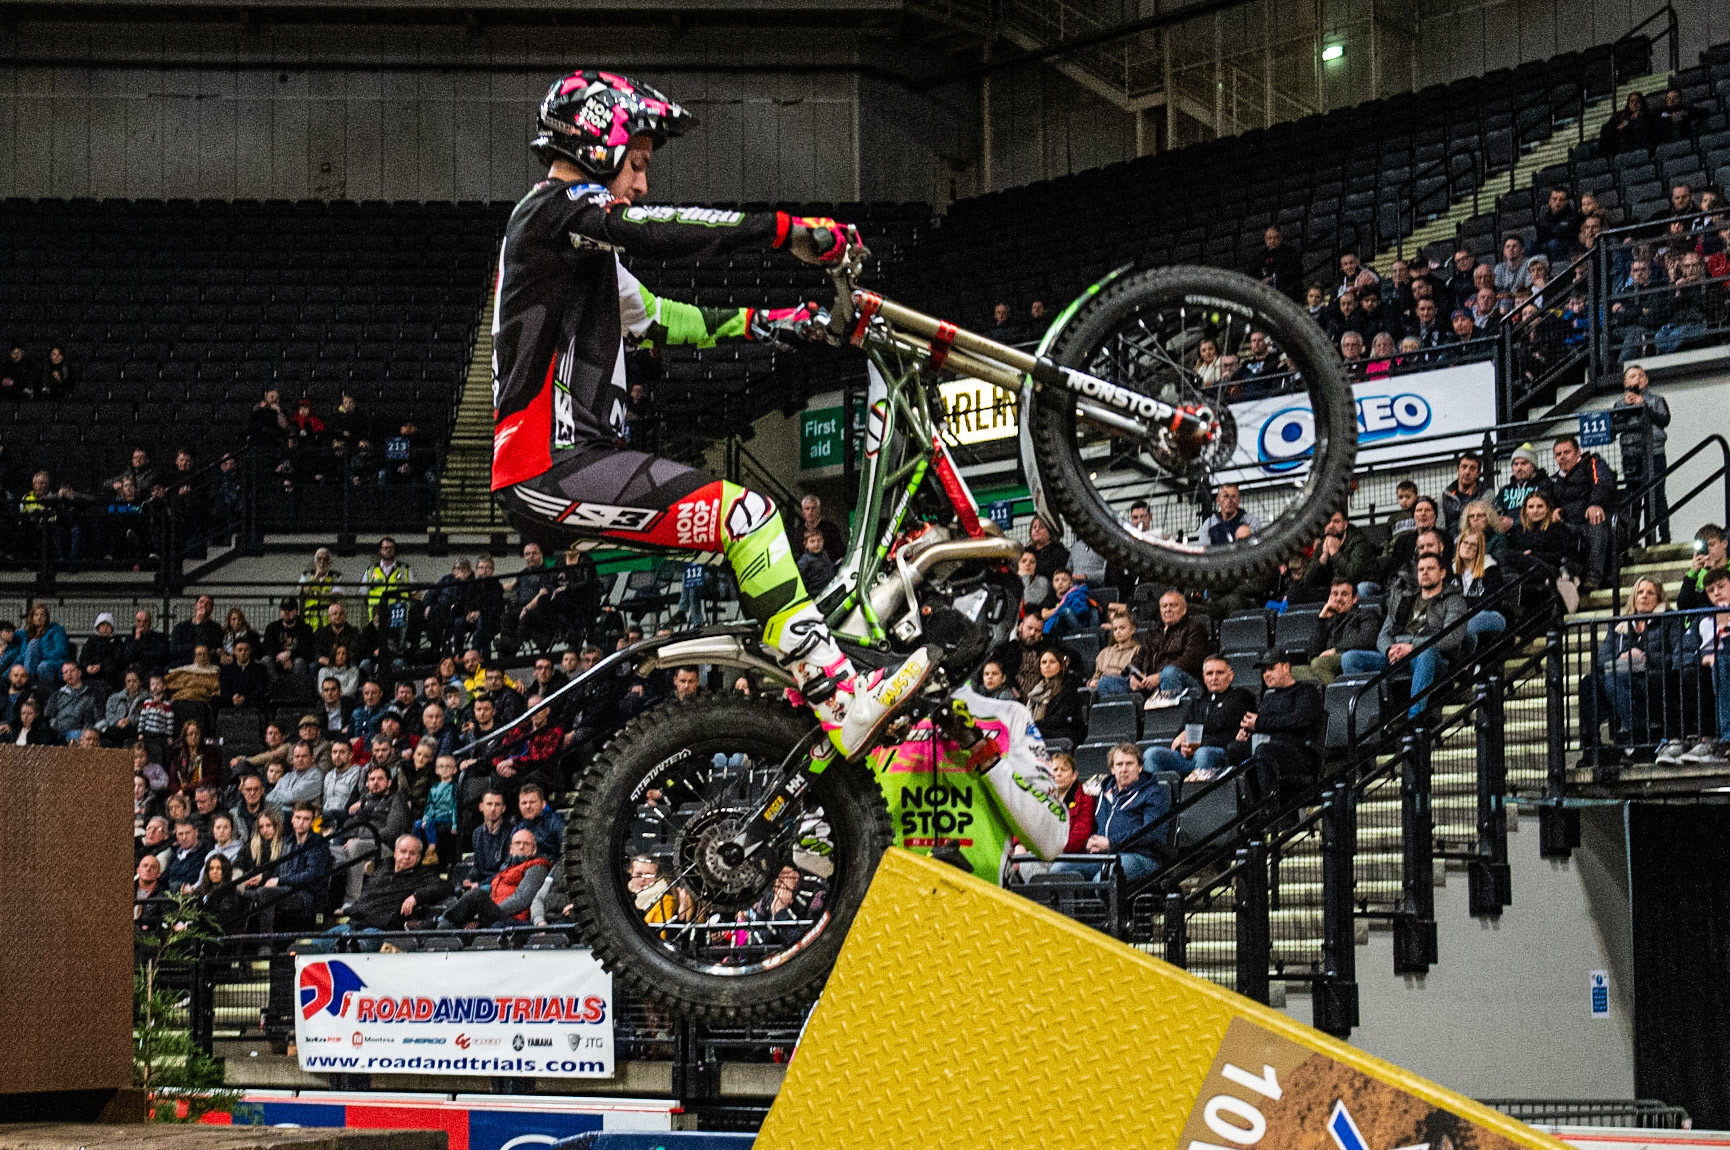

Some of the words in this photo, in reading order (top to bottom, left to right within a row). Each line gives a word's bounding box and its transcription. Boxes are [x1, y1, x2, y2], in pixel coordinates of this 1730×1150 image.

[585, 97, 614, 122] NON
[1066, 369, 1172, 421] NONSTOP
[805, 418, 836, 438] First
[1259, 394, 1431, 466] OEO
[1583, 419, 1606, 434] 111
[388, 442, 407, 451] 213
[810, 440, 831, 458] aid
[676, 502, 694, 545] NON
[693, 500, 712, 543] STOP
[990, 507, 1008, 520] 111
[686, 566, 702, 578] 112
[901, 786, 973, 808] NON
[901, 811, 974, 834] STOP
[357, 994, 607, 1024] ROADANDTRIALS
[527, 1036, 553, 1048] YAMAHA
[585, 1036, 604, 1048] JTG
[305, 1054, 605, 1073] www.roadandtrials.com
